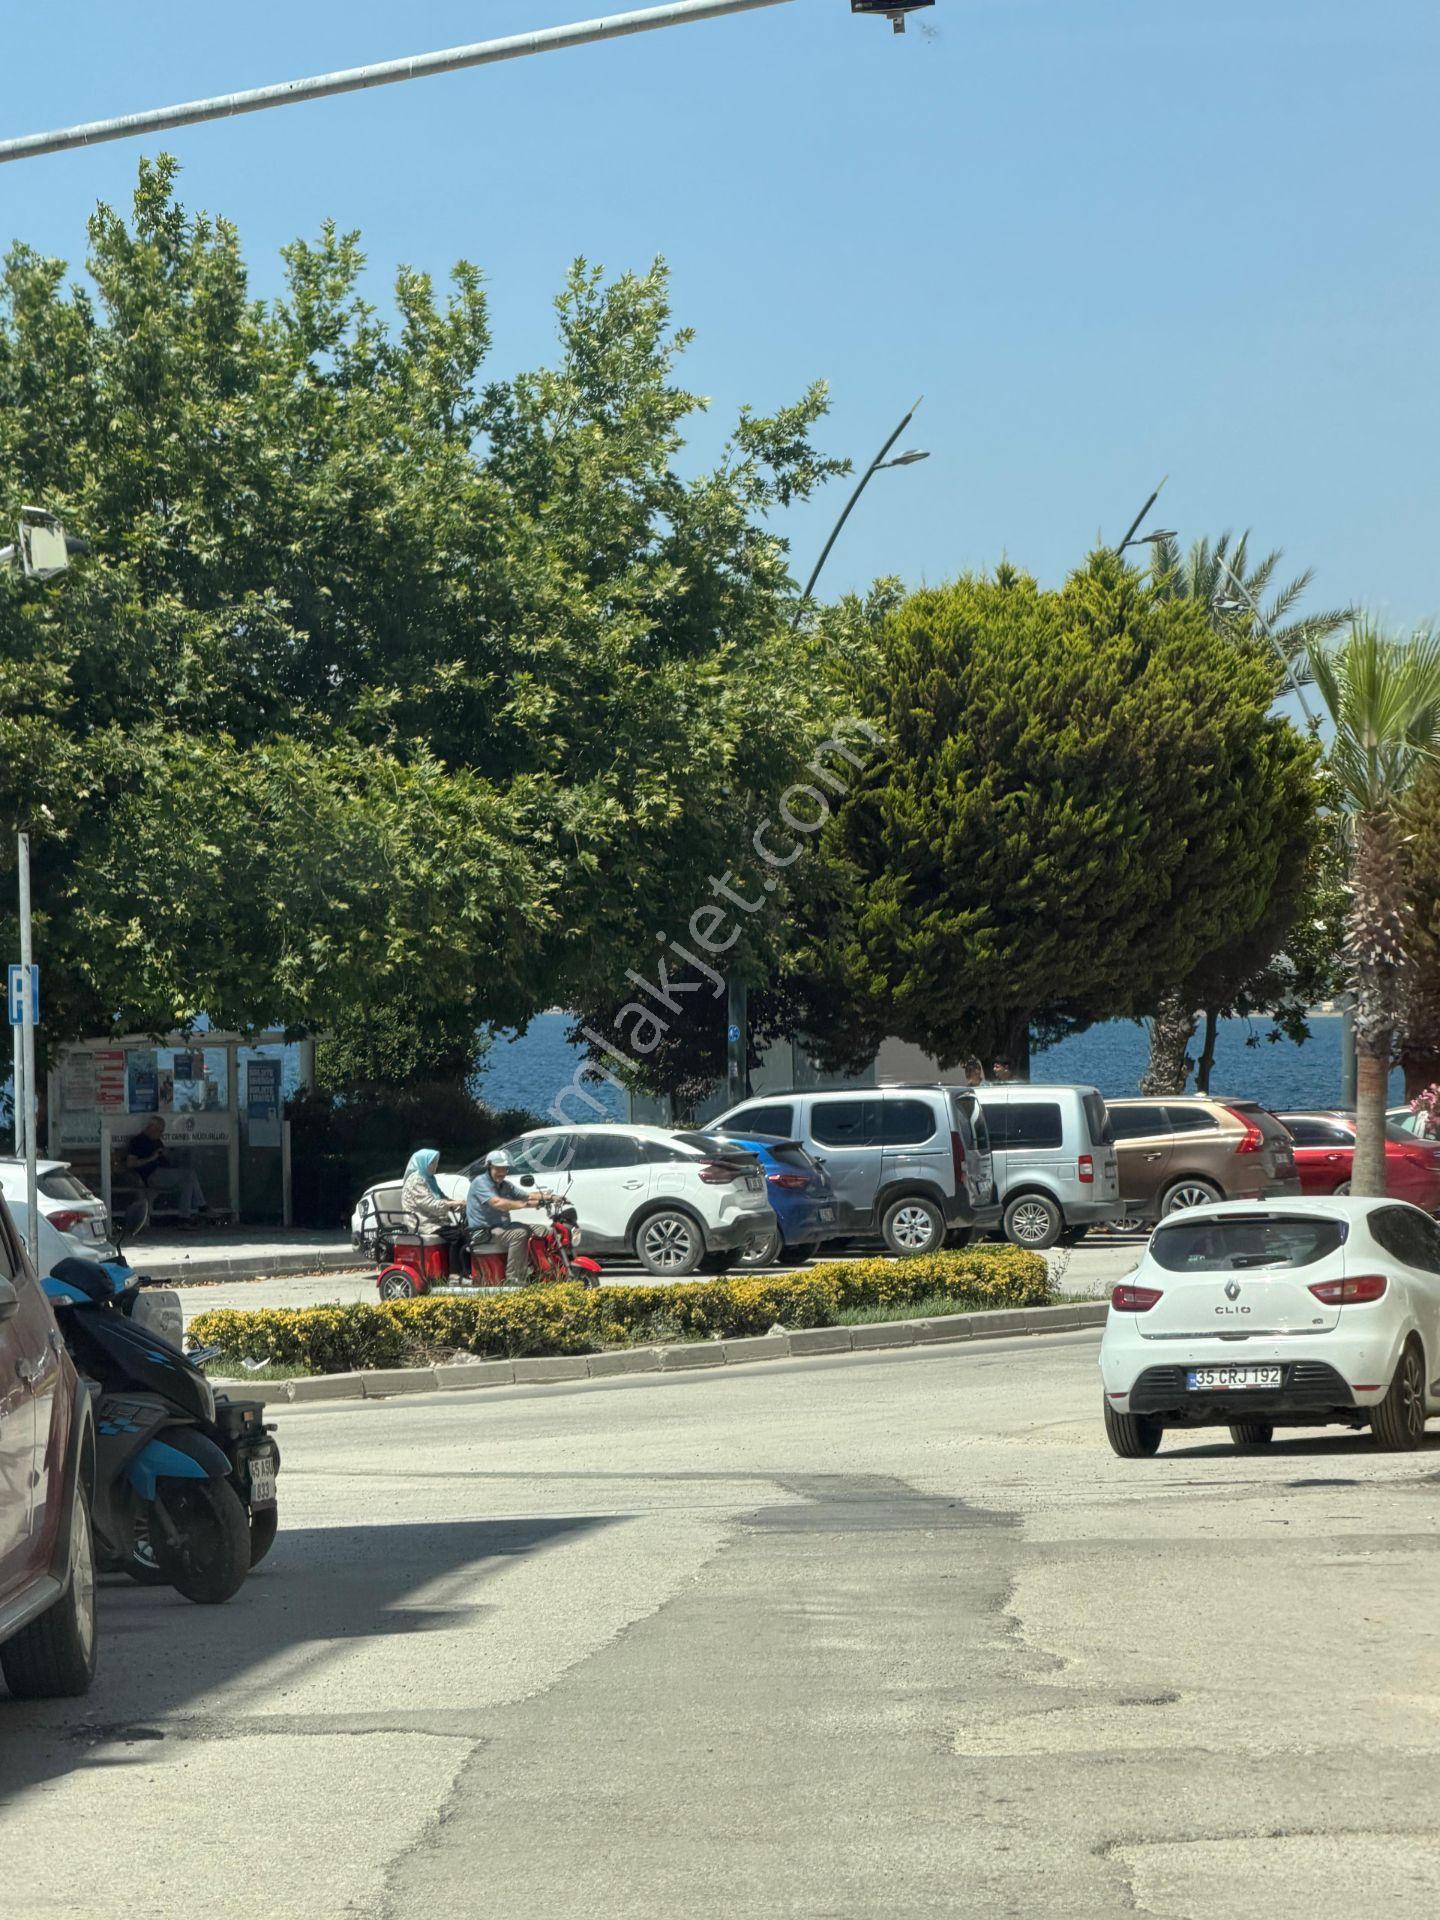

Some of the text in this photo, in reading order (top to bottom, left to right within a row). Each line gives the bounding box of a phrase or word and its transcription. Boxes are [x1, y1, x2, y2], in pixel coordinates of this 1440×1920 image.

[1215, 1306, 1251, 1314] CLIO
[1196, 1367, 1280, 1384] 35 CRJ 192
